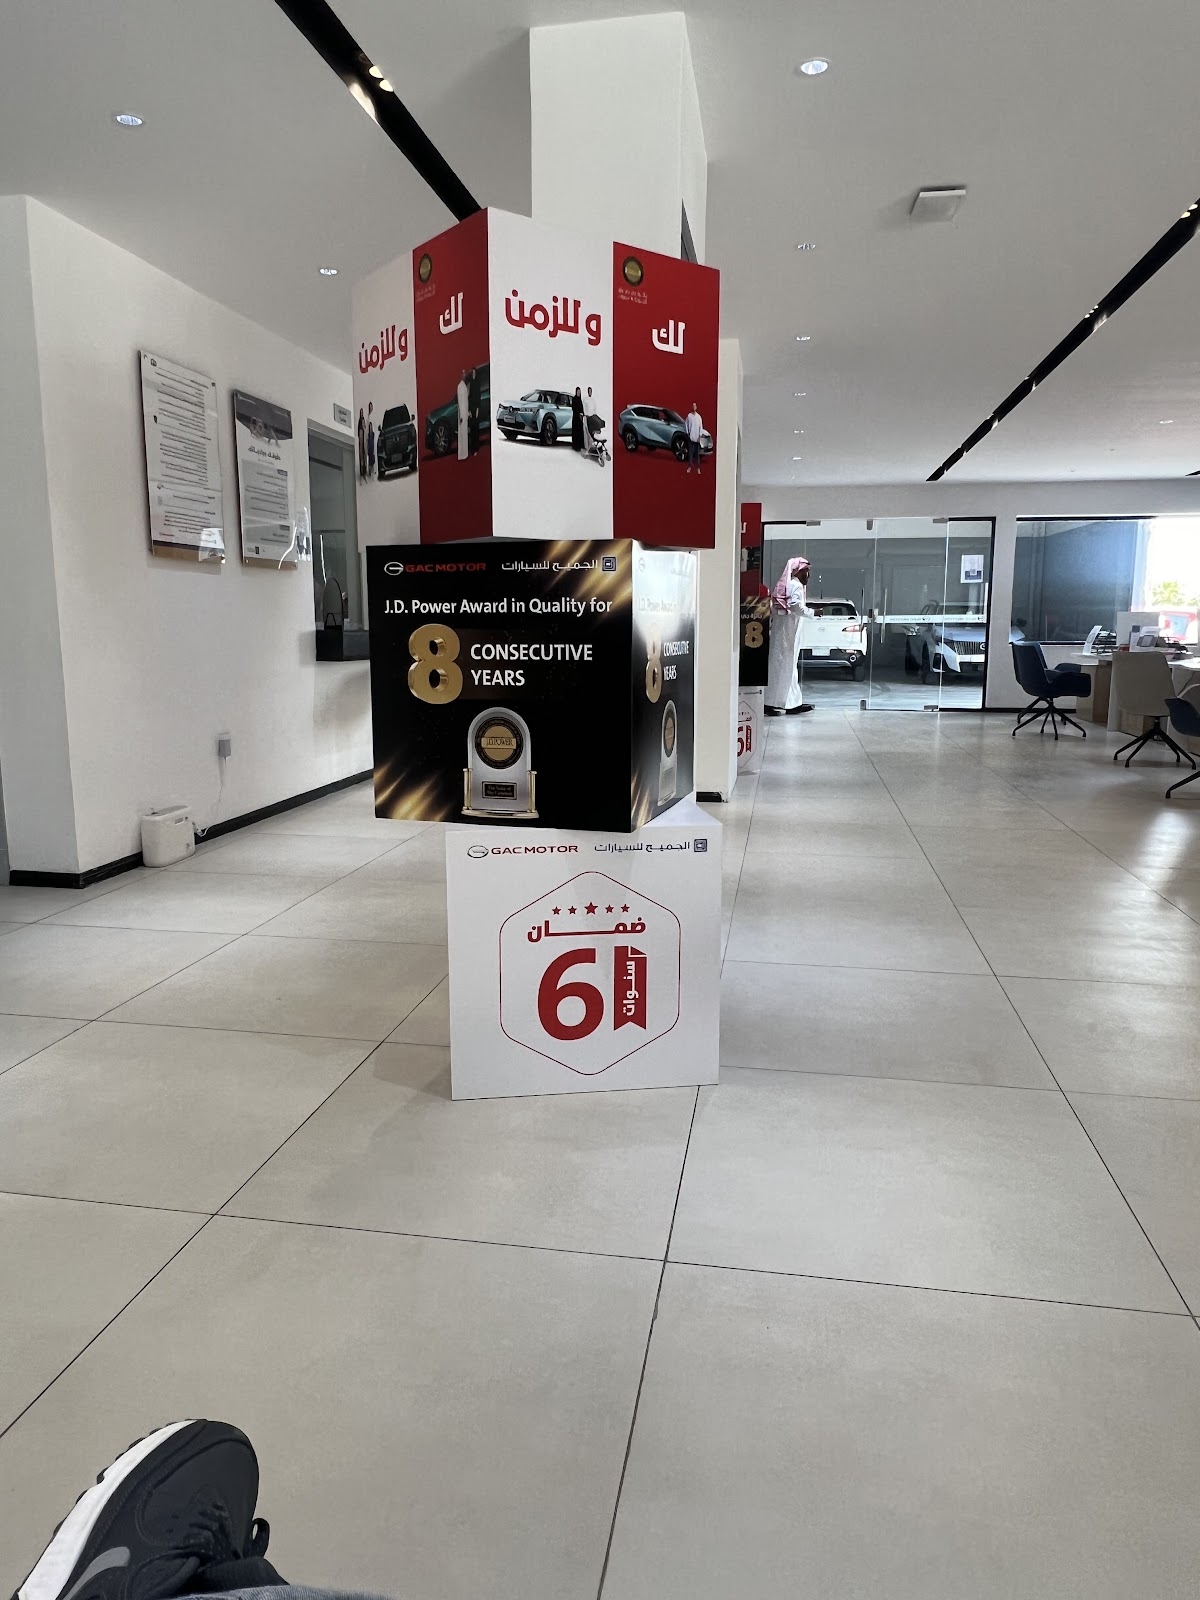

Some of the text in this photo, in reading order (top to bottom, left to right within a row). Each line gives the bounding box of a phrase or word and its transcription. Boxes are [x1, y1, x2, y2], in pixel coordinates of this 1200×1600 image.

[439, 292, 464, 335] لك
[651, 319, 687, 355] لك
[405, 562, 487, 573] GAC MOTOR
[501, 560, 550, 573] للسيارات
[384, 597, 613, 617] J.D. Power Award in Quality for
[470, 644, 593, 661] CONSECUTIVE
[408, 623, 463, 705] 8
[663, 665, 678, 681] YEARS
[471, 669, 526, 687] YEARS
[491, 845, 578, 856] GAC MOTOR
[594, 843, 642, 855] للسيارات
[527, 916, 647, 943] ضمان
[538, 948, 605, 1041] 6
[623, 961, 640, 1016] سنوات
